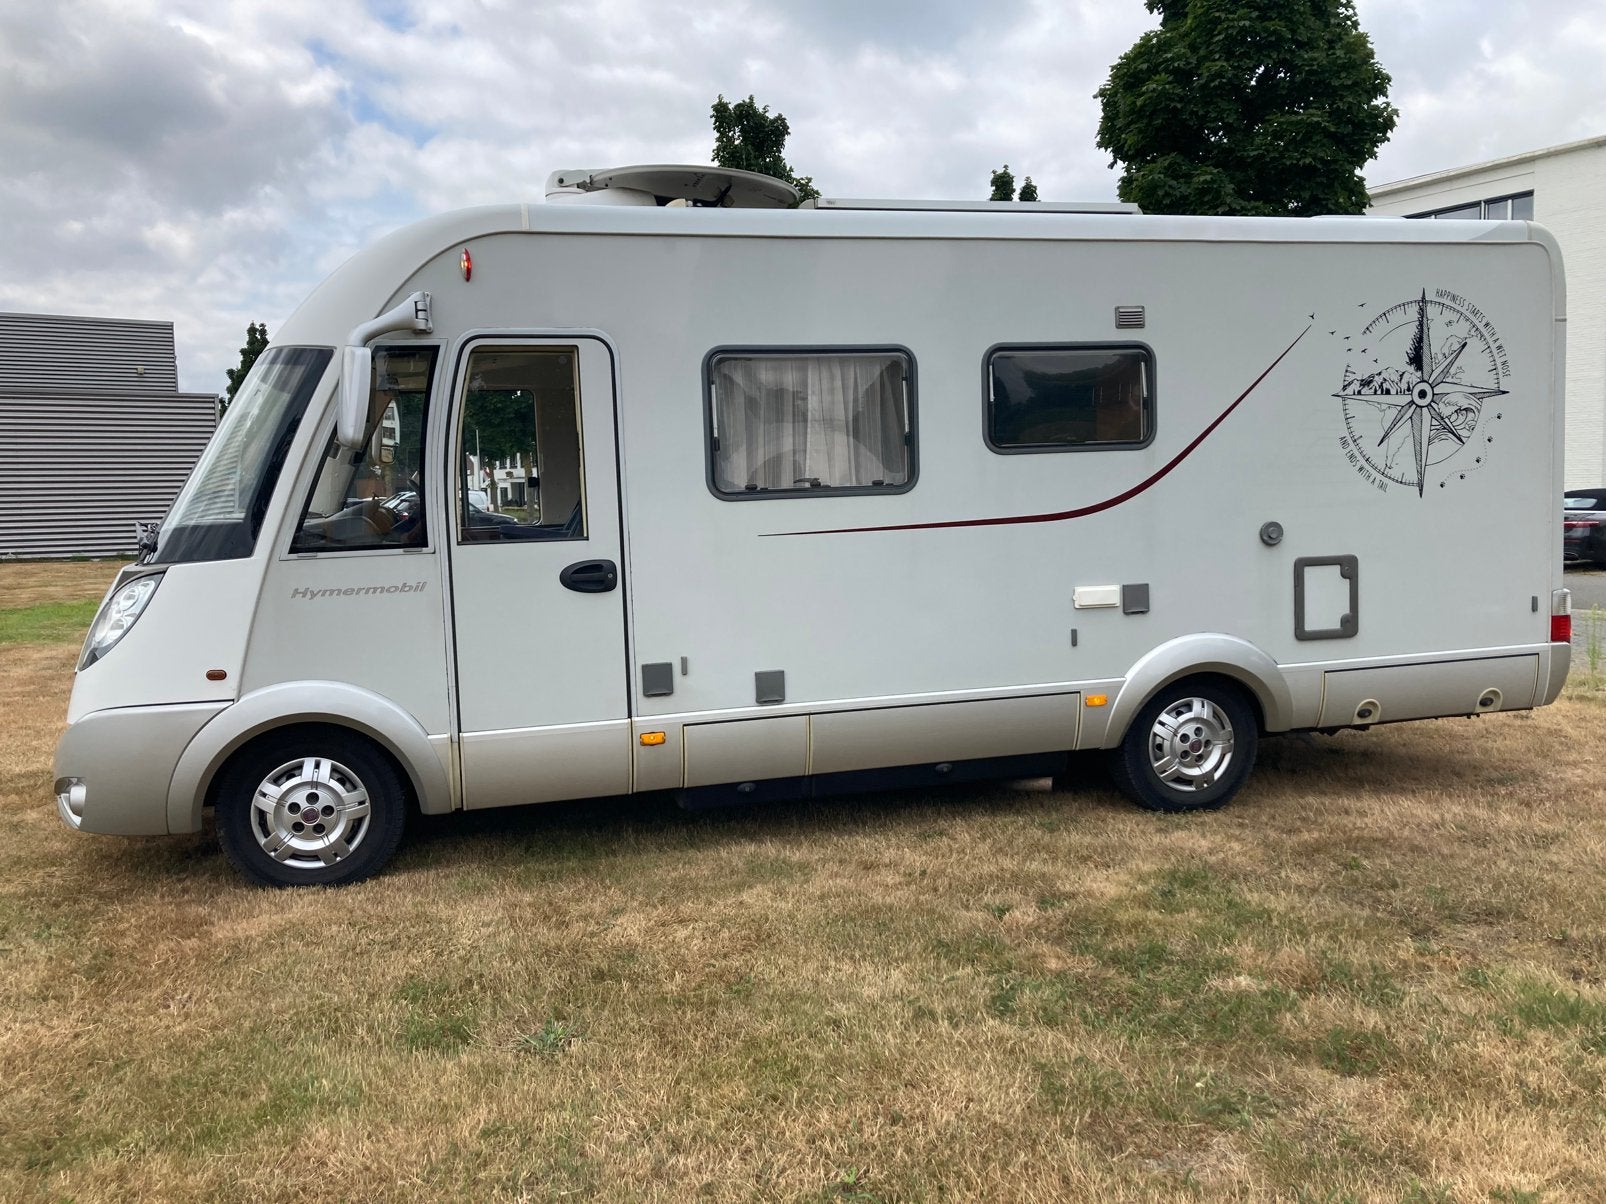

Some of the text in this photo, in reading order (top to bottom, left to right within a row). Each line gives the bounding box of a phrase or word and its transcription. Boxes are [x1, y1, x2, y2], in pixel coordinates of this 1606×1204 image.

[1435, 288, 1466, 308] HAPPINESS
[1466, 302, 1486, 323] STARTS
[1483, 320, 1497, 338] WITH
[1495, 344, 1507, 358] WET
[1500, 360, 1511, 378] NOSE
[1339, 436, 1350, 449] AND
[1345, 450, 1360, 467] ENDS
[1357, 465, 1372, 481] WITH
[1377, 479, 1389, 493] TAIL
[291, 581, 428, 600] Hymermobil
